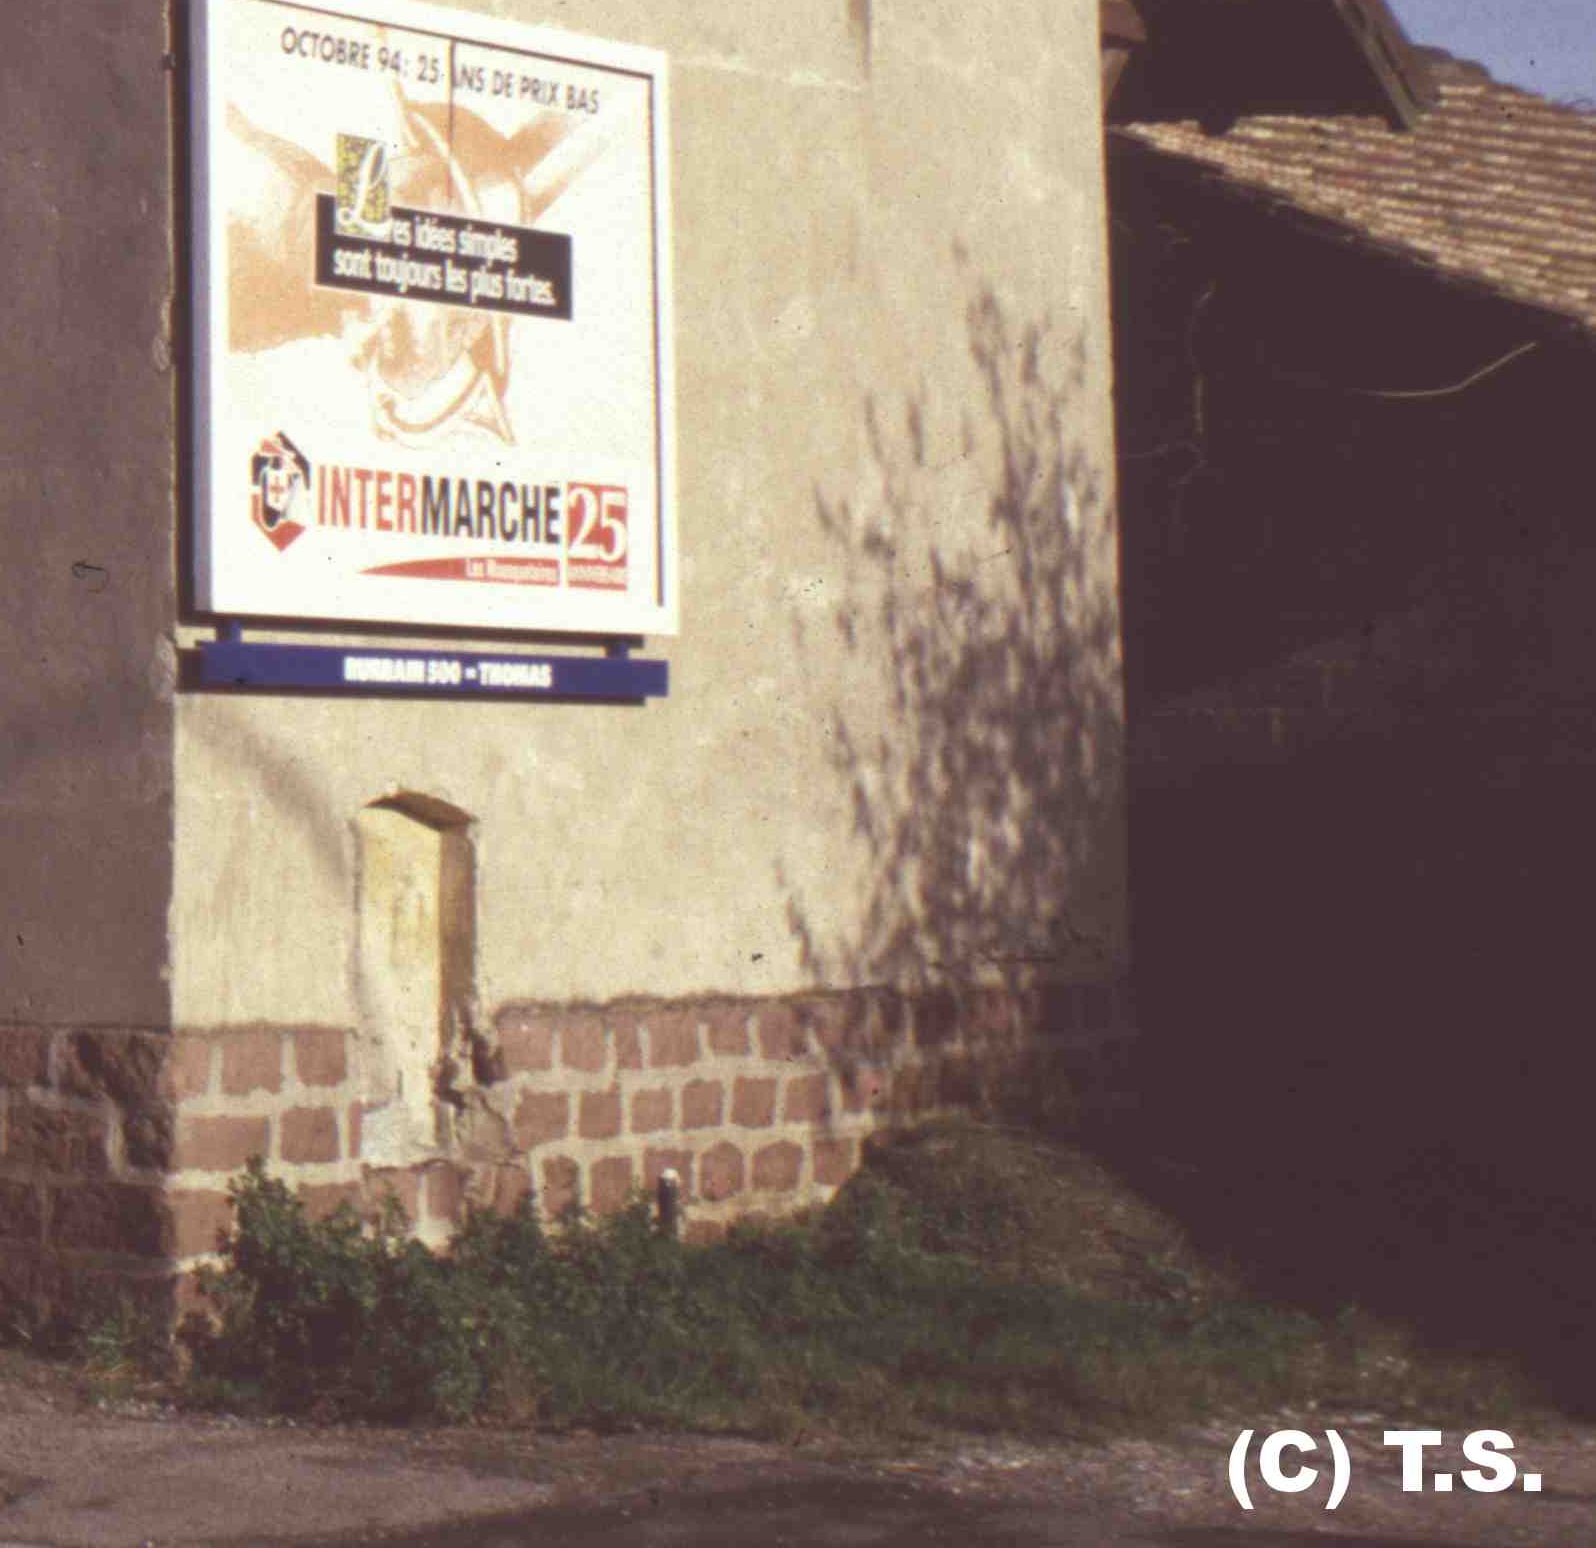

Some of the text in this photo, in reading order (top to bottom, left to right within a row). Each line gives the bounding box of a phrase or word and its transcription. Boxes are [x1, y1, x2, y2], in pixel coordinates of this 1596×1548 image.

[281, 26, 370, 68] OCTOBRE
[417, 54, 439, 84] 25
[491, 70, 514, 98] DE
[519, 74, 561, 107] PRIX
[567, 83, 601, 114] BAS
[332, 248, 557, 306] sont toujours les plus fortes.
[414, 215, 457, 254] idées
[458, 222, 519, 268] simples
[317, 464, 628, 563] INTERMARCHE 25
